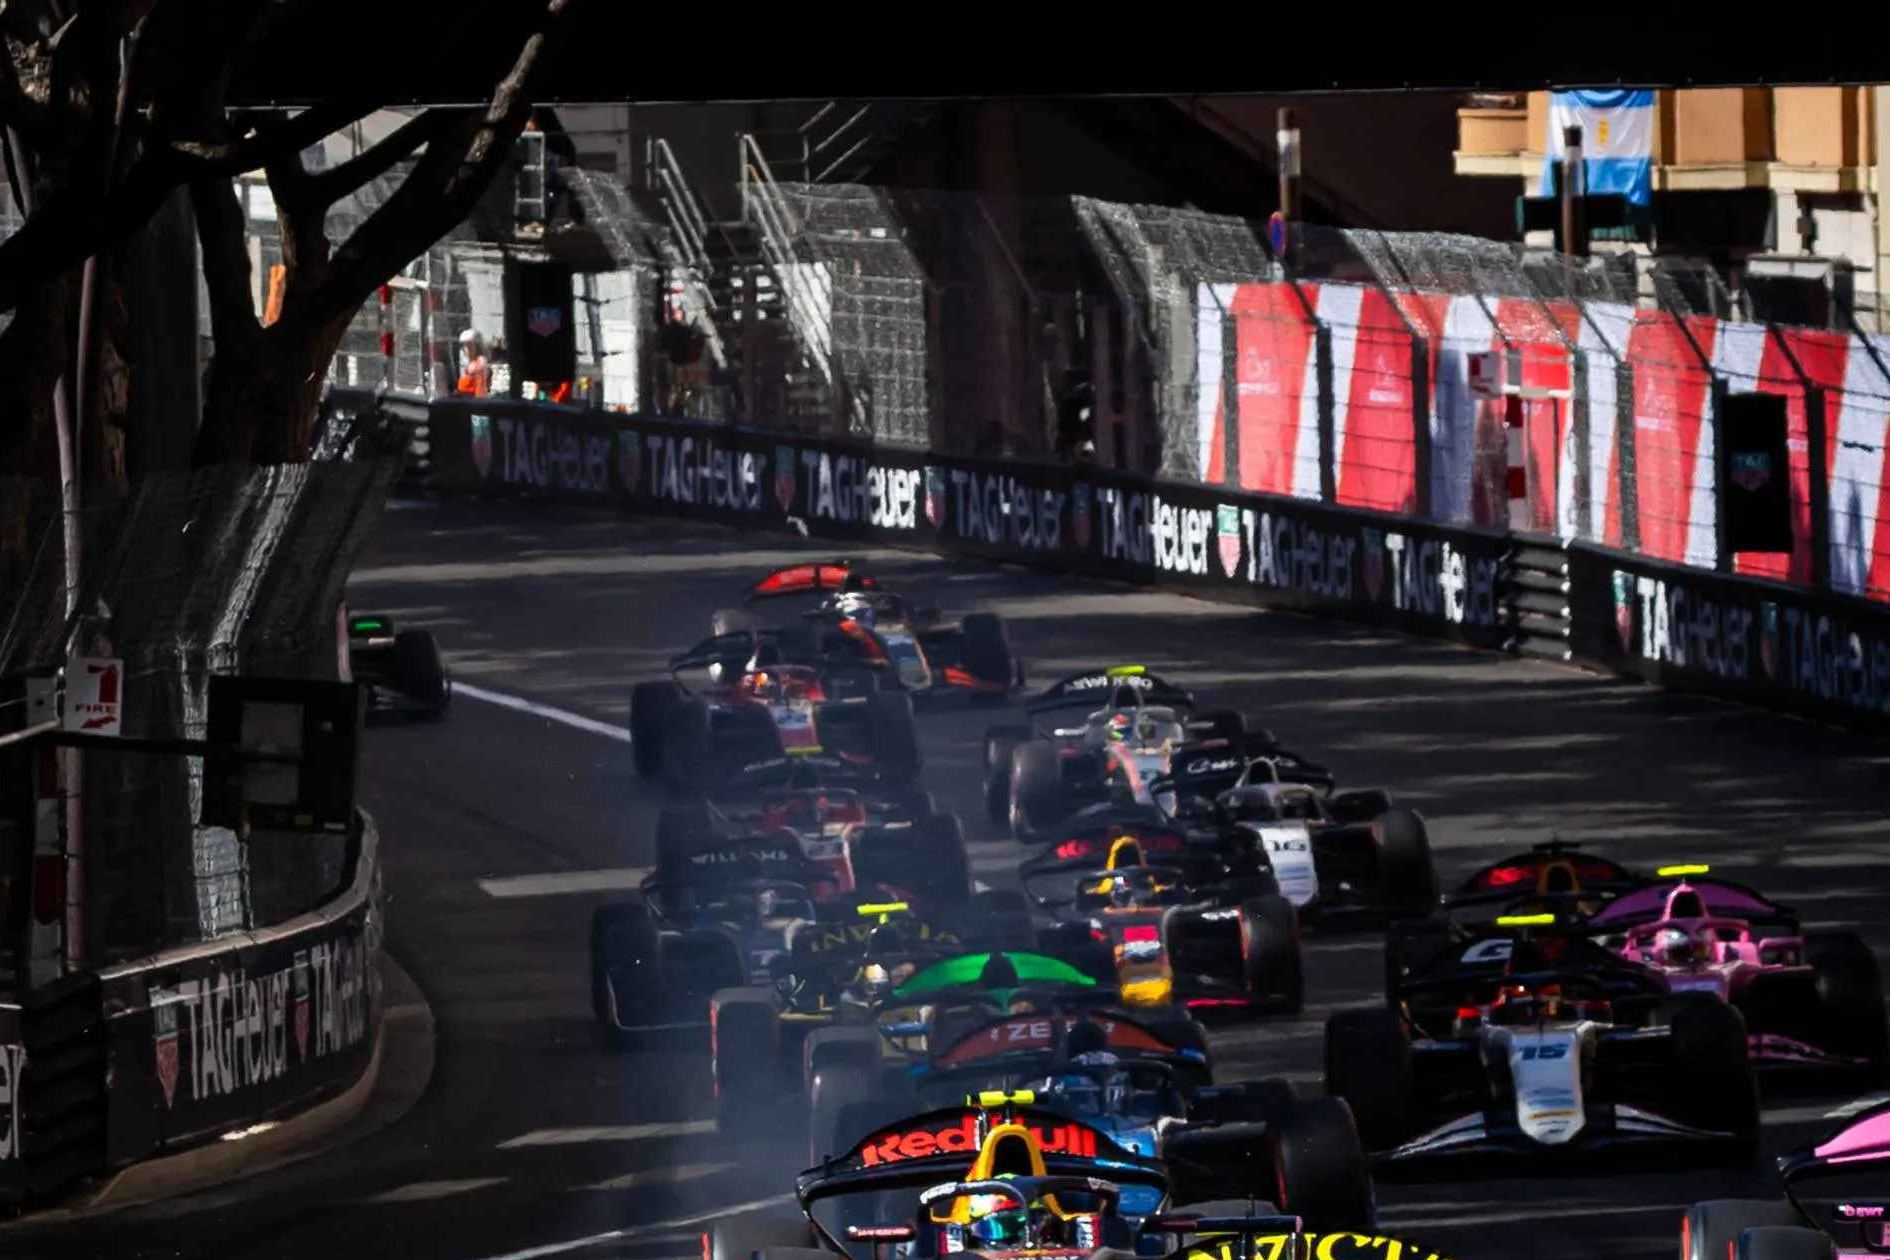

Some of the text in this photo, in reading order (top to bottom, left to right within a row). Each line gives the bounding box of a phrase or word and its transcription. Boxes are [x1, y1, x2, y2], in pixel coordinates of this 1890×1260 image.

[801, 451, 920, 529] TAGHeuer
[1096, 487, 1211, 575] TAGHeuer
[862, 1113, 1098, 1169] Red ull
